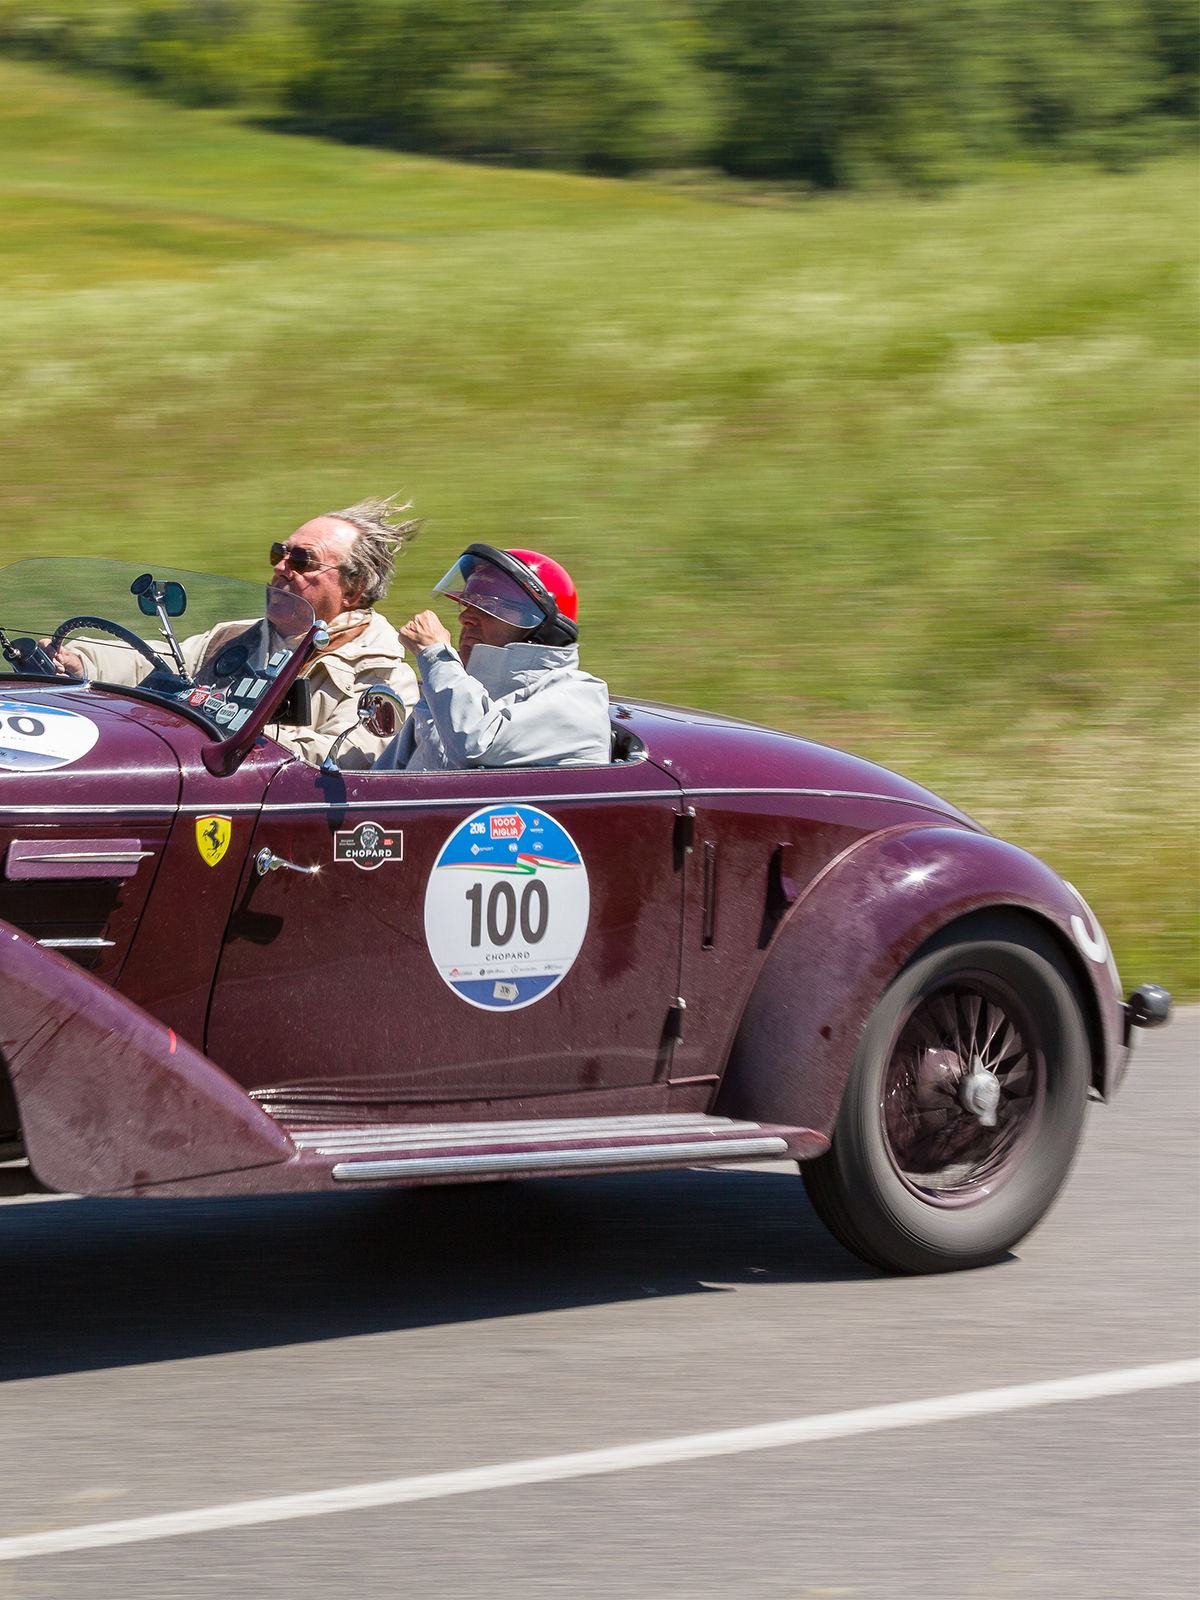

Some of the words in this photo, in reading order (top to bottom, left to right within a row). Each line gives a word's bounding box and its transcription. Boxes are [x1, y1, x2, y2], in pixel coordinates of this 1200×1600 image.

[493, 817, 517, 828] 1000
[469, 822, 486, 835] 2016
[492, 827, 519, 837] MIGLIA
[345, 849, 393, 858] CHOPARD
[465, 879, 549, 948] 100
[485, 951, 531, 962] CHOPARD
